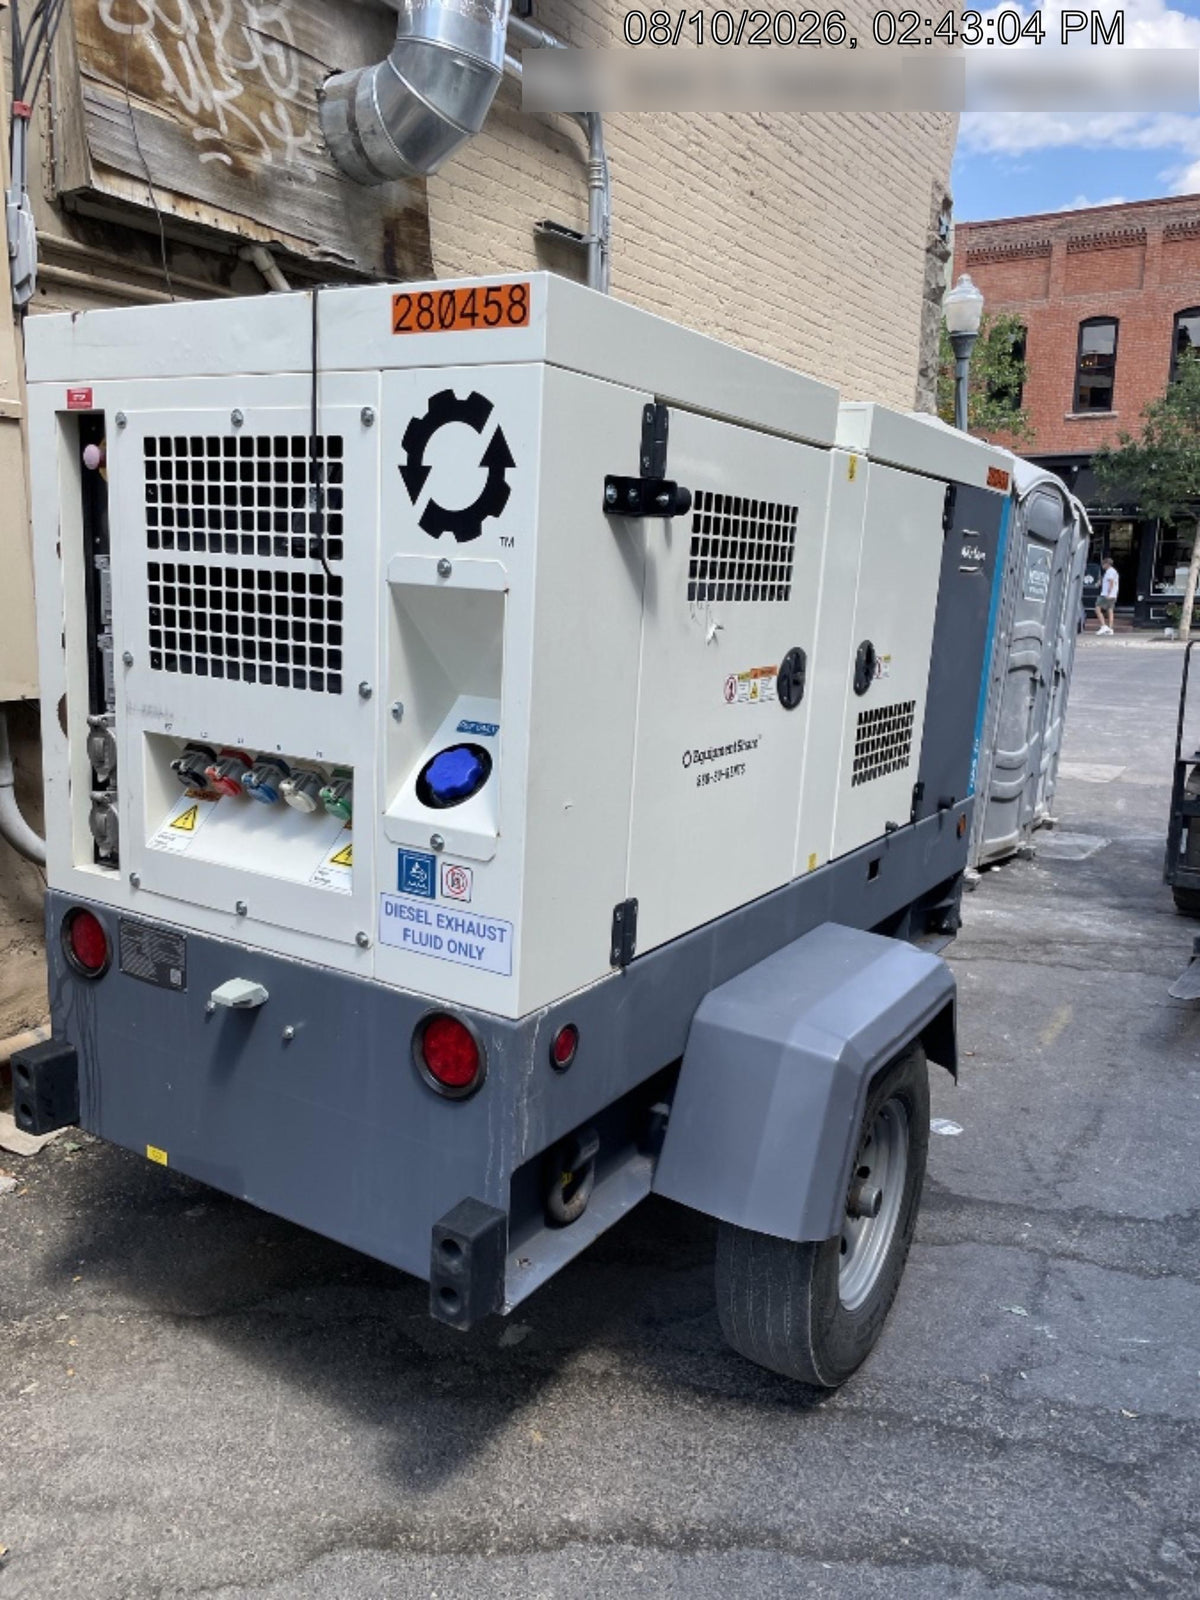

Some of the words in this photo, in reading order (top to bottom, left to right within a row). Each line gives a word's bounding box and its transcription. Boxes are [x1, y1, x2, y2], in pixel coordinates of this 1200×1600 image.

[394, 284, 527, 331] 280458
[385, 901, 432, 925] DIESEL
[436, 914, 507, 942] EXHAUST
[403, 928, 443, 950] FLUID
[447, 940, 485, 960] ONLY
